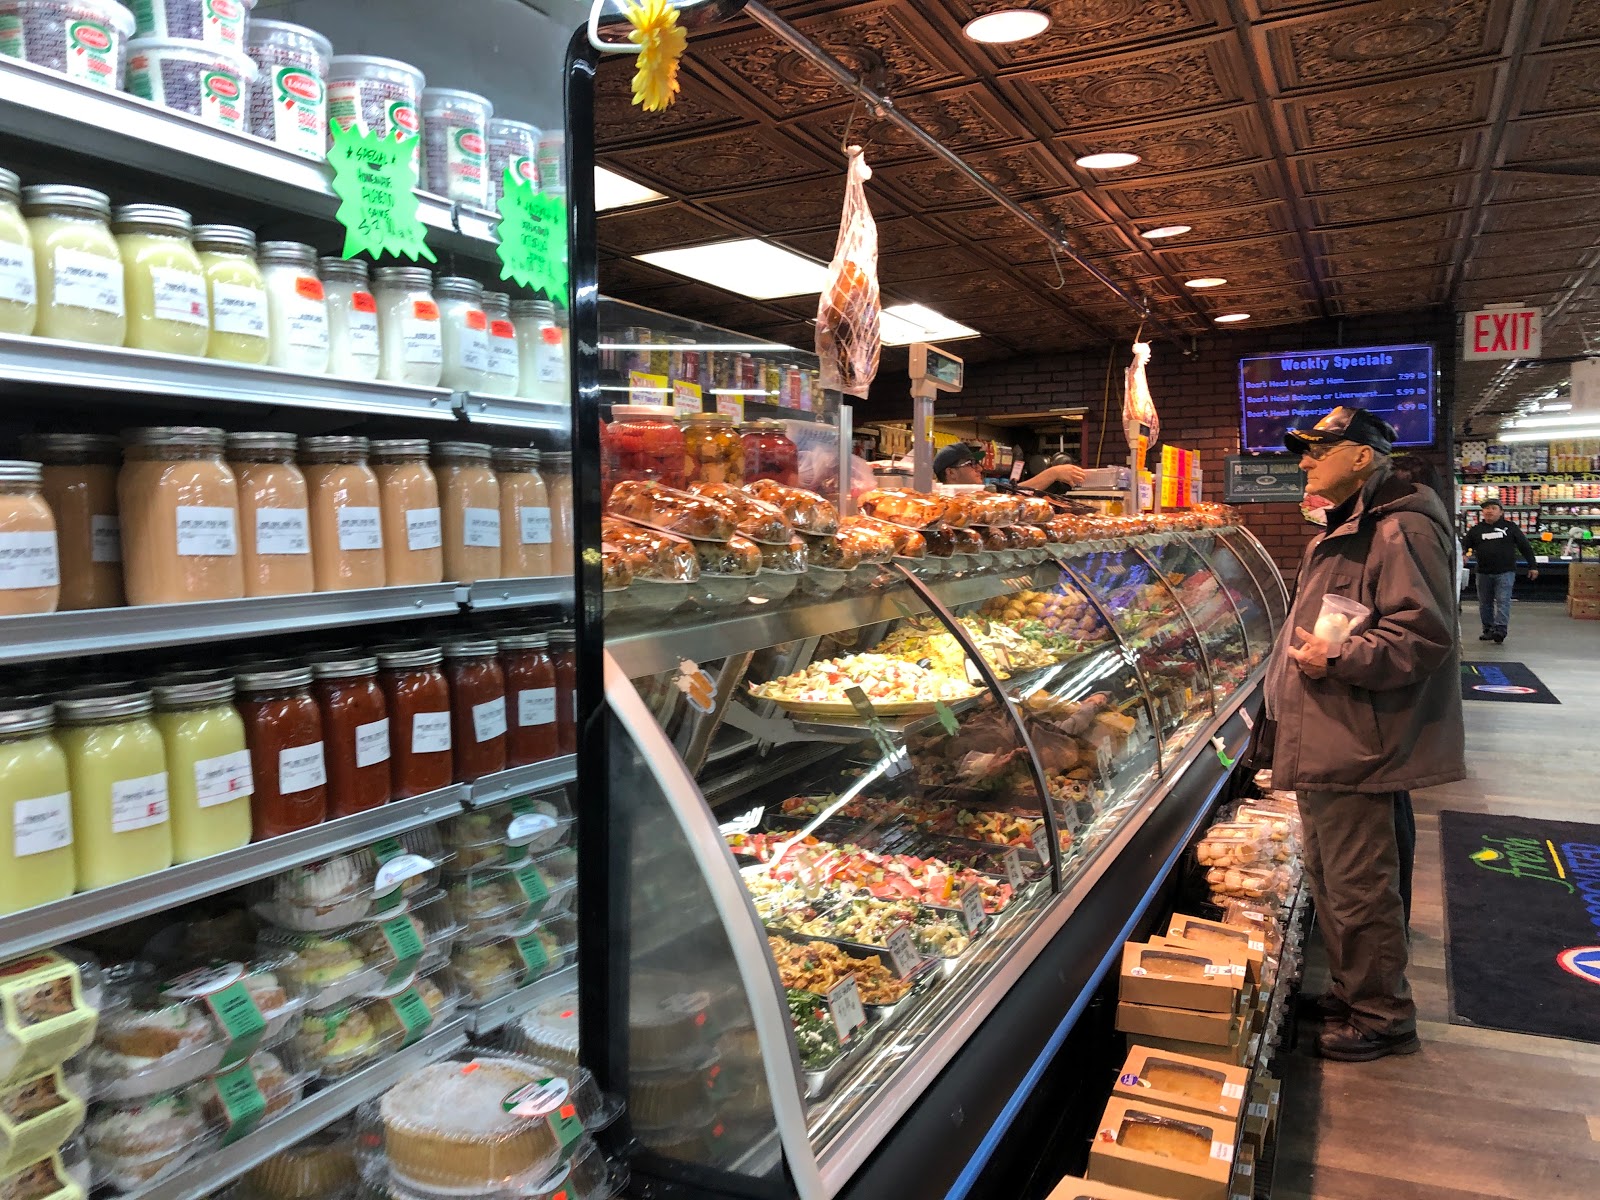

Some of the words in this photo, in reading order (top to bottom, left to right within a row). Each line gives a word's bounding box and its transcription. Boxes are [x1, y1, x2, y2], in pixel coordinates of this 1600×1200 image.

[1474, 312, 1535, 352] EXIT
[1281, 357, 1330, 371] Weekly
[1333, 353, 1393, 369] Specials
[1309, 378, 1325, 386] Salt
[1326, 377, 1345, 385] Ham
[1270, 394, 1290, 402] Head
[1291, 393, 1321, 402] Bologna
[1334, 391, 1378, 399] Liverwurst
[1417, 387, 1427, 395] lb
[1270, 409, 1290, 417] Head
